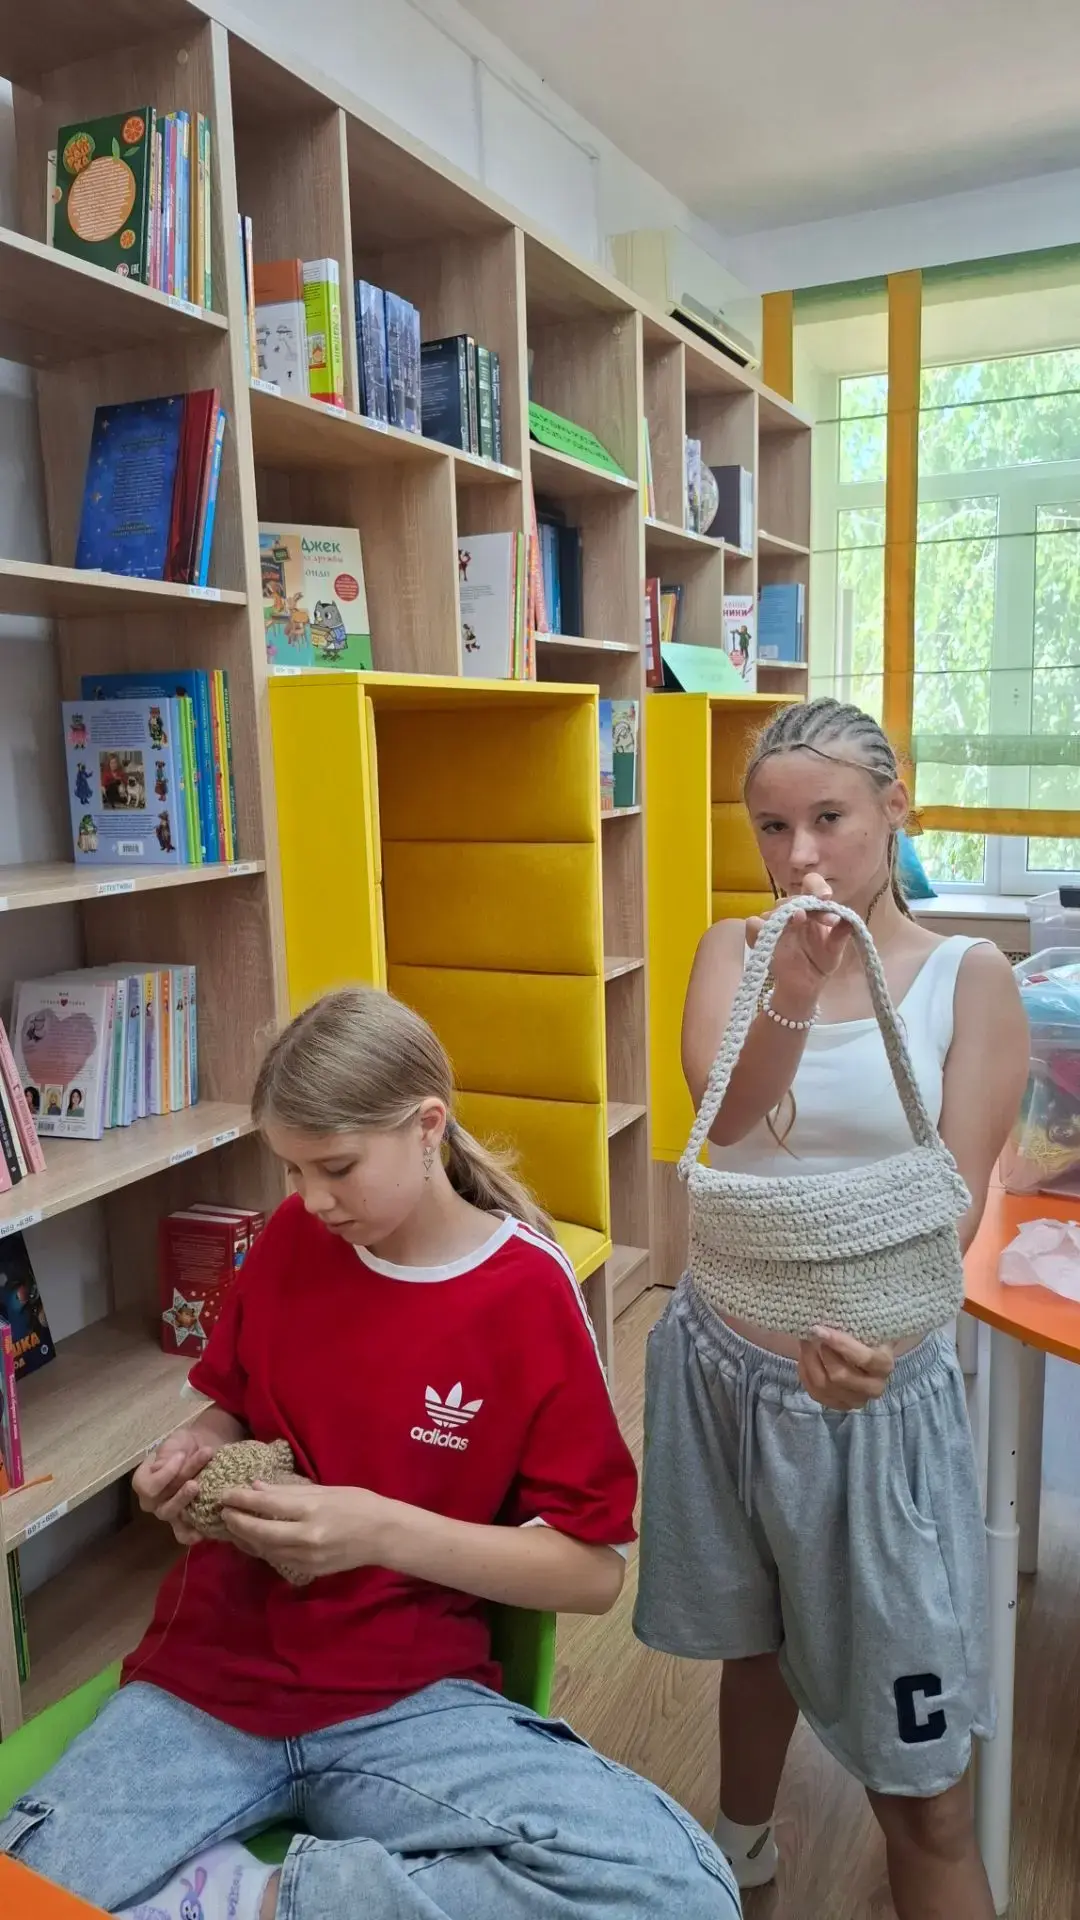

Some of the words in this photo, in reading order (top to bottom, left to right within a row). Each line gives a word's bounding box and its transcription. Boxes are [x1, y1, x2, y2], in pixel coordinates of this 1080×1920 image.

[301, 537, 341, 553] Джек
[410, 1426, 469, 1451] adidas
[893, 1672, 948, 1744] C
